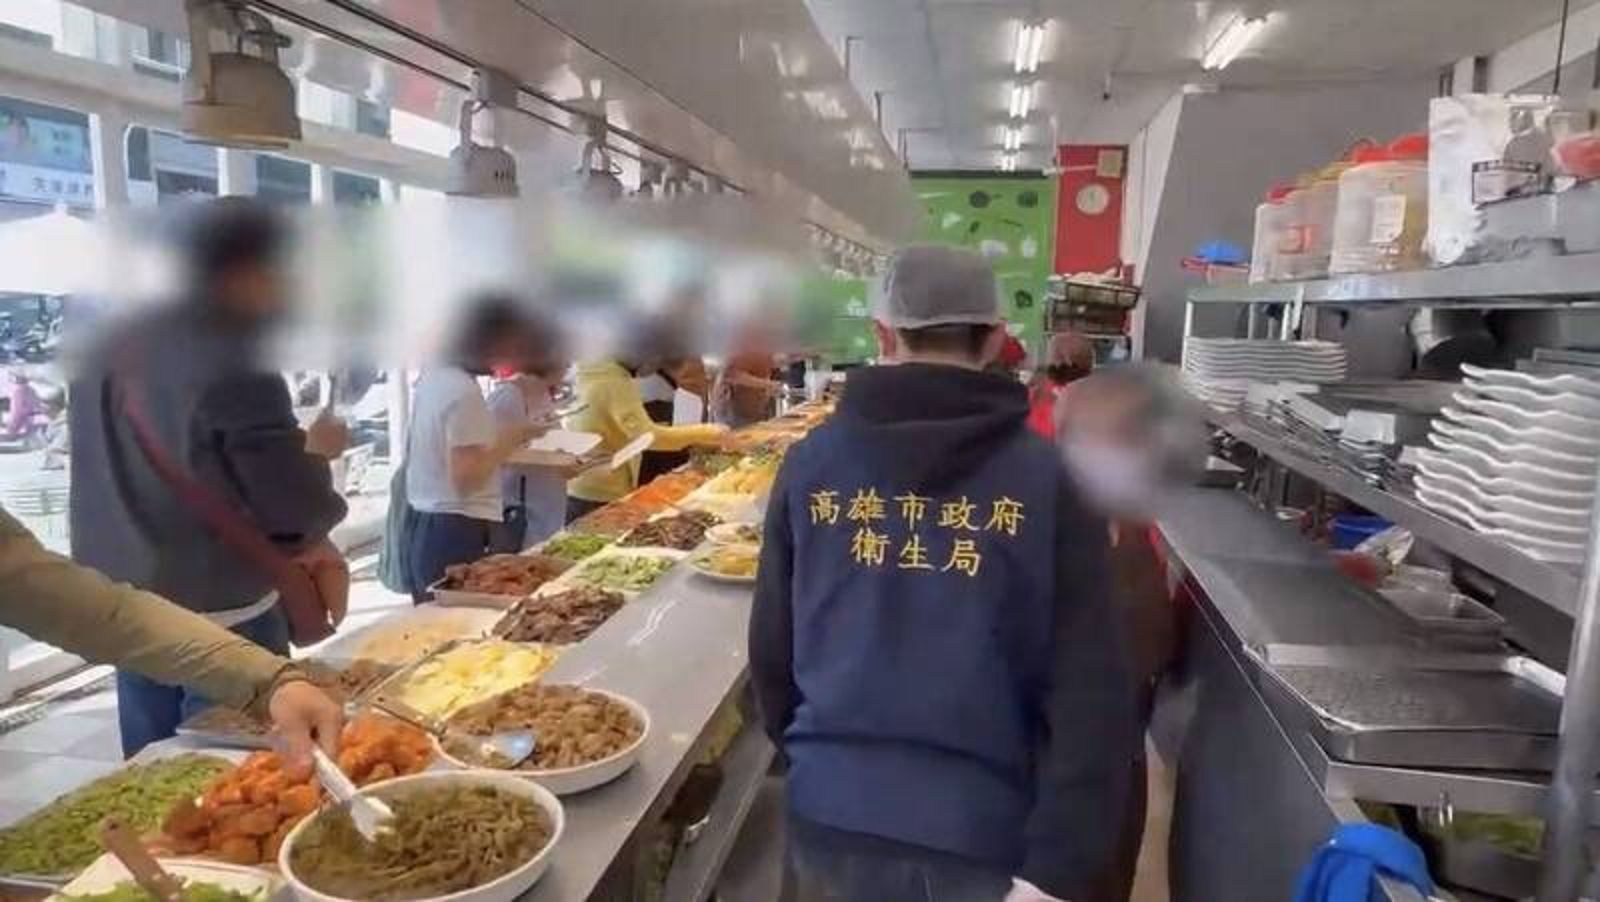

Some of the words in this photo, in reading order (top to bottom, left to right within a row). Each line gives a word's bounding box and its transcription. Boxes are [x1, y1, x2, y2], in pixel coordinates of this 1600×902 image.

[808, 486, 1025, 536] 高雄市政府
